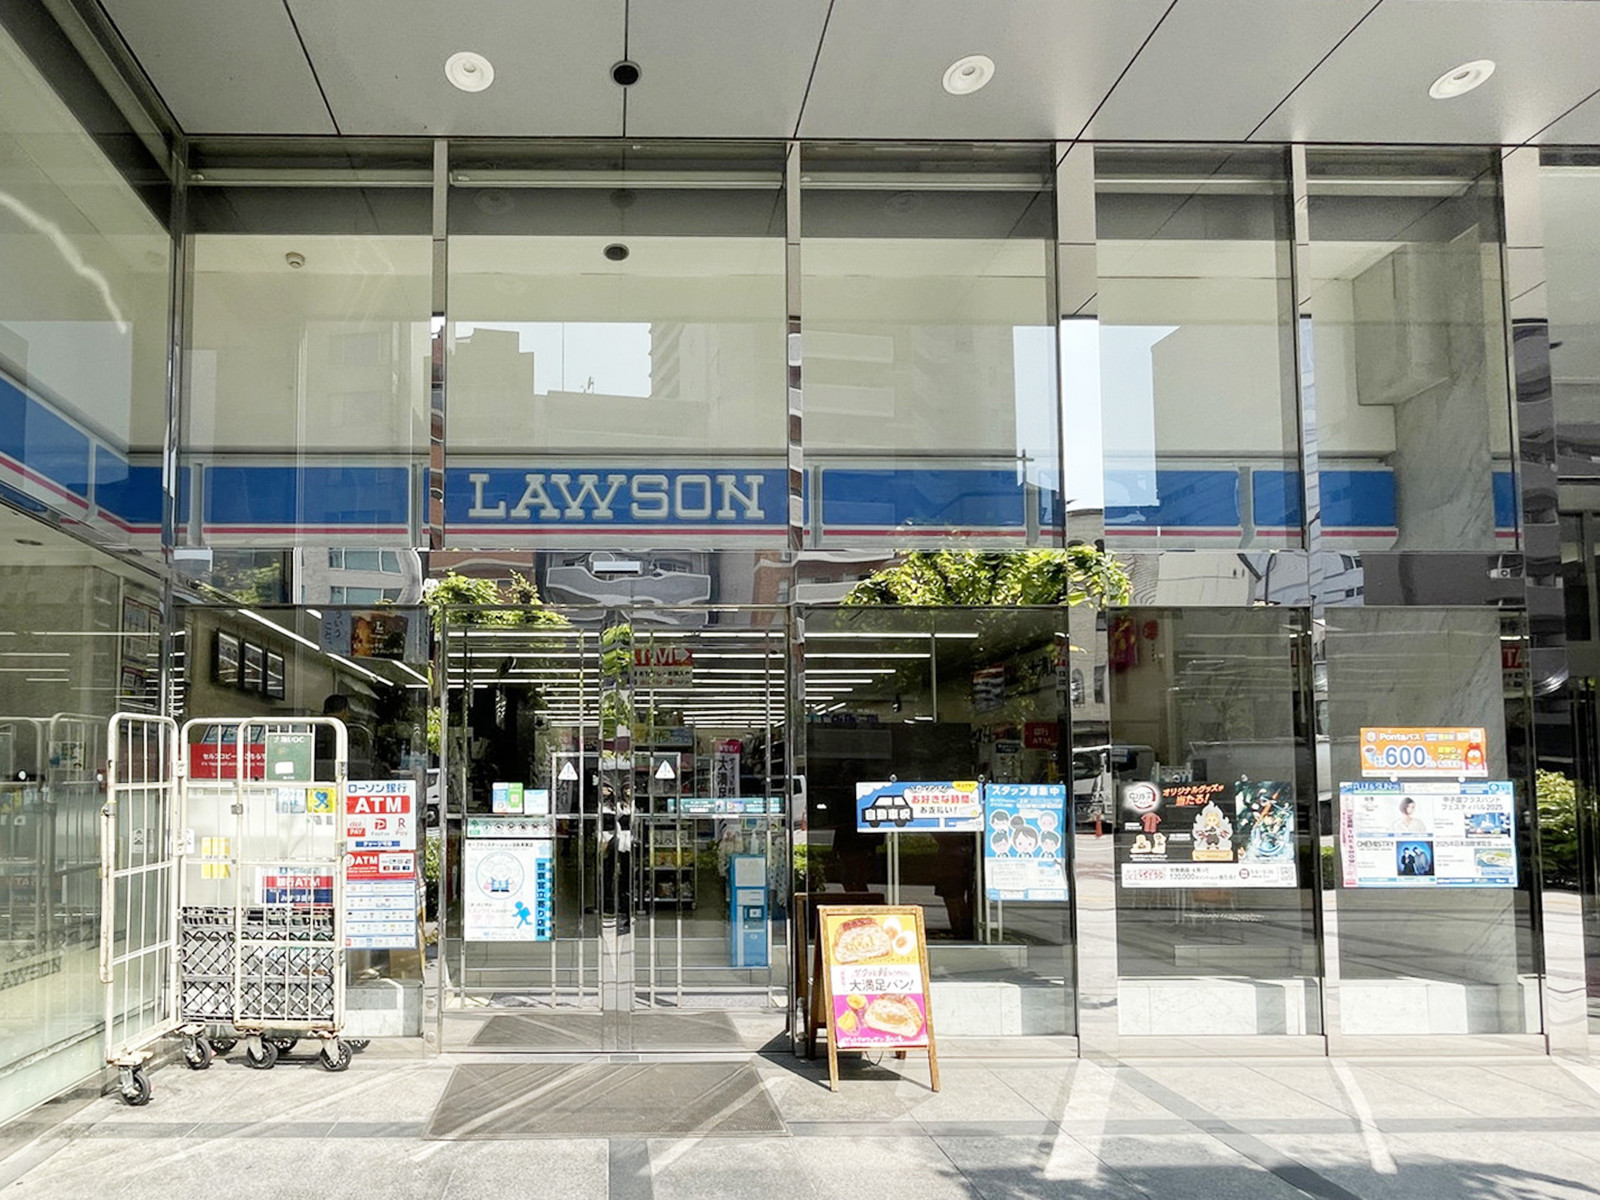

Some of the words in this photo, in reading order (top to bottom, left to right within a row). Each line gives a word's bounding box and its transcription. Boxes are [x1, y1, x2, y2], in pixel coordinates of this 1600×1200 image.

[468, 473, 765, 519] LAWSON
[1386, 747, 1425, 765] 600
[348, 783, 407, 794] ローソン銀行
[992, 785, 1060, 796] スタッフ募集中
[1162, 783, 1225, 797] オリジナルグッズが
[354, 797, 402, 813] ATM
[1175, 793, 1210, 807] 当たる!
[354, 856, 378, 865] ATM
[849, 979, 914, 992] 大満足パン!
